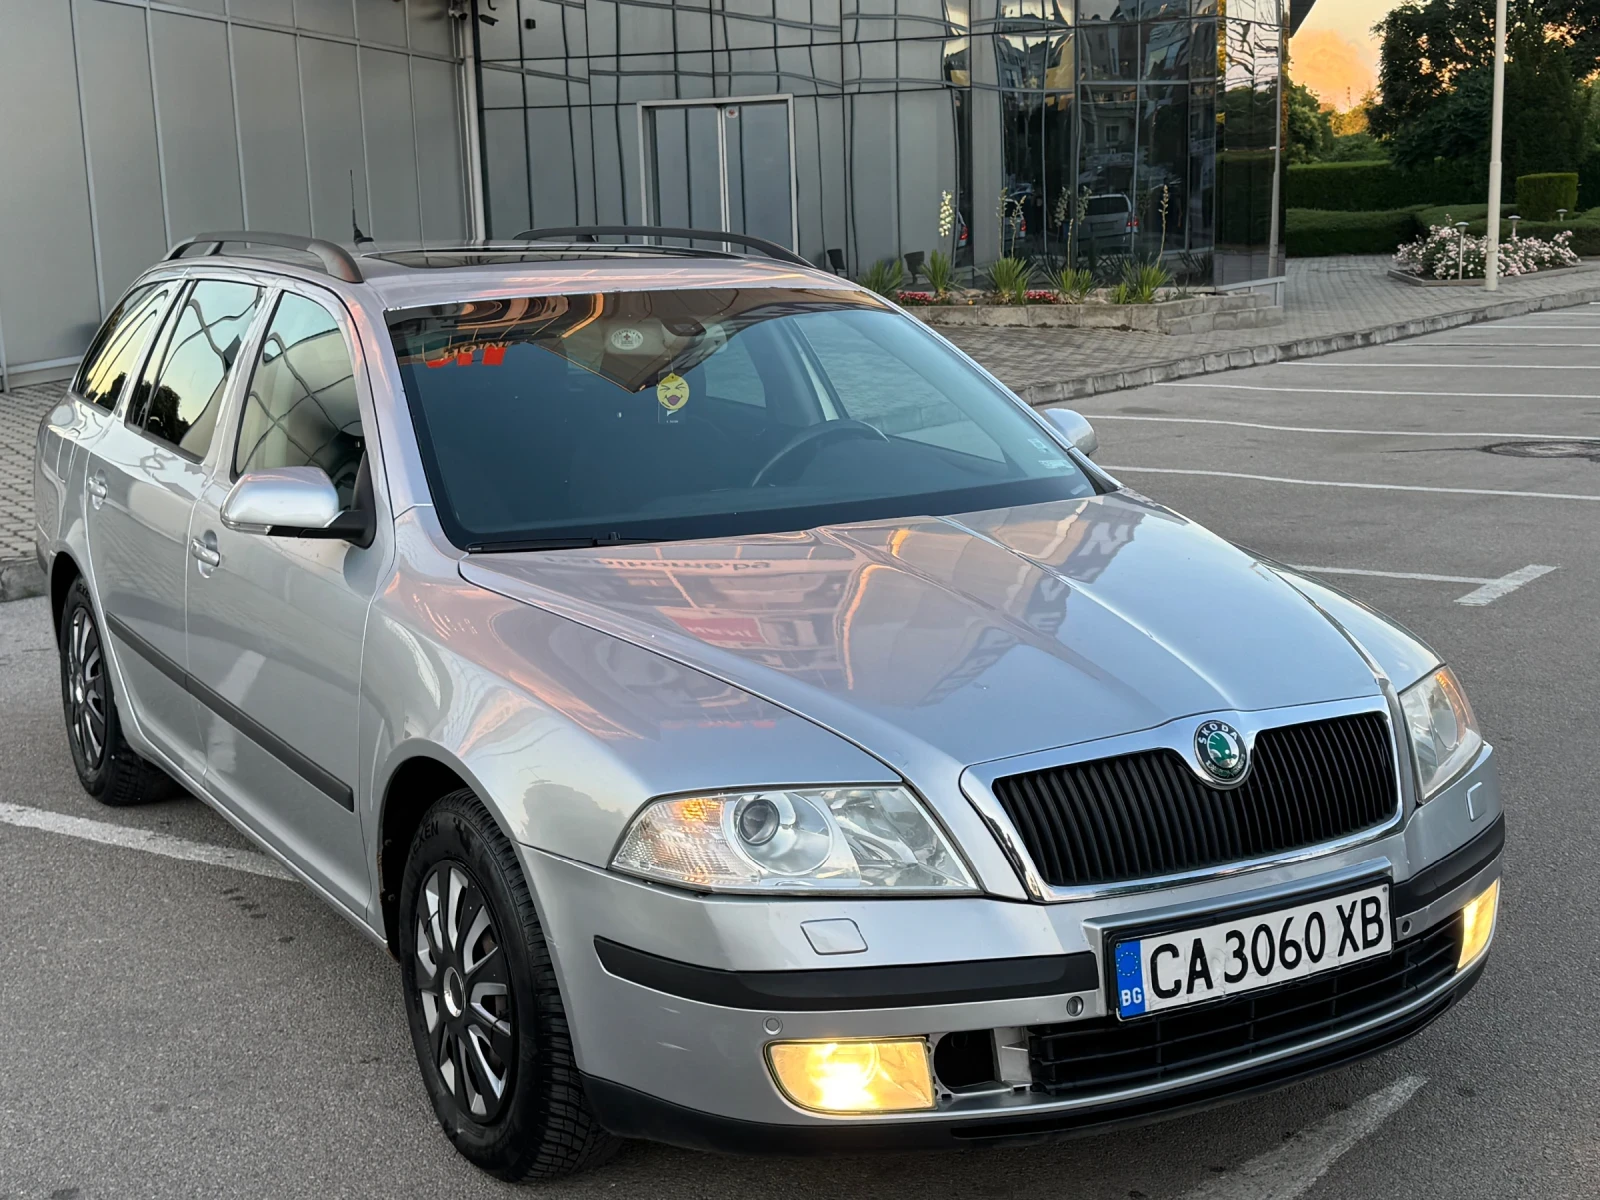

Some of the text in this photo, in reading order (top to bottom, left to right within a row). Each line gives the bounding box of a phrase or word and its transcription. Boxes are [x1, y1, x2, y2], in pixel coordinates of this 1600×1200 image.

[1150, 895, 1384, 999] CA 3060 XB
[1121, 988, 1142, 1007] BG
